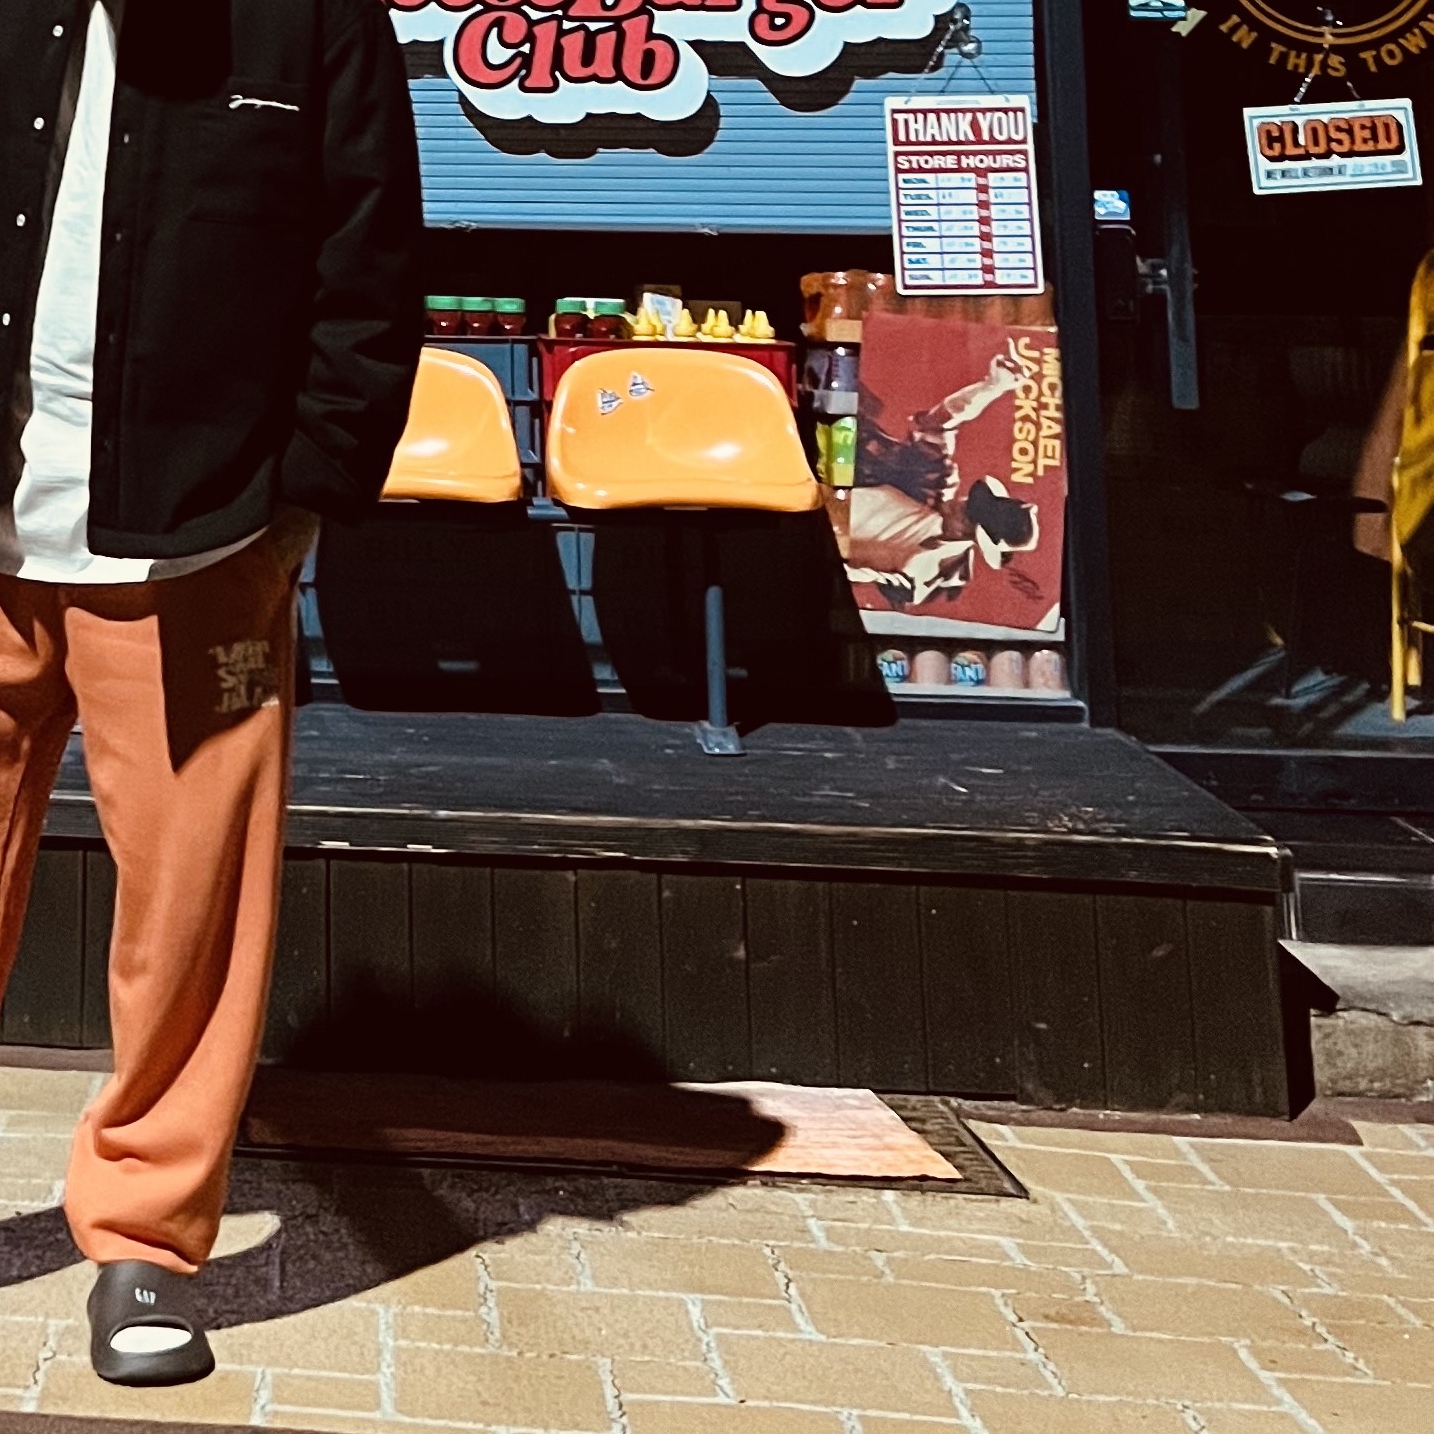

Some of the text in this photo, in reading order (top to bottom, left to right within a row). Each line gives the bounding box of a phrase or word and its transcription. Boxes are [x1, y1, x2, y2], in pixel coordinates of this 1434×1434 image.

[453, 8, 682, 94] Club
[1218, 14, 1259, 51] IN
[1269, 41, 1348, 78] THIS
[892, 110, 1026, 143] THANK YOU
[1256, 114, 1402, 158] CLOSED
[896, 153, 1027, 170] STORE HOURS
[1010, 336, 1041, 485] JACKSON
[1036, 347, 1063, 477] MICHAEL
